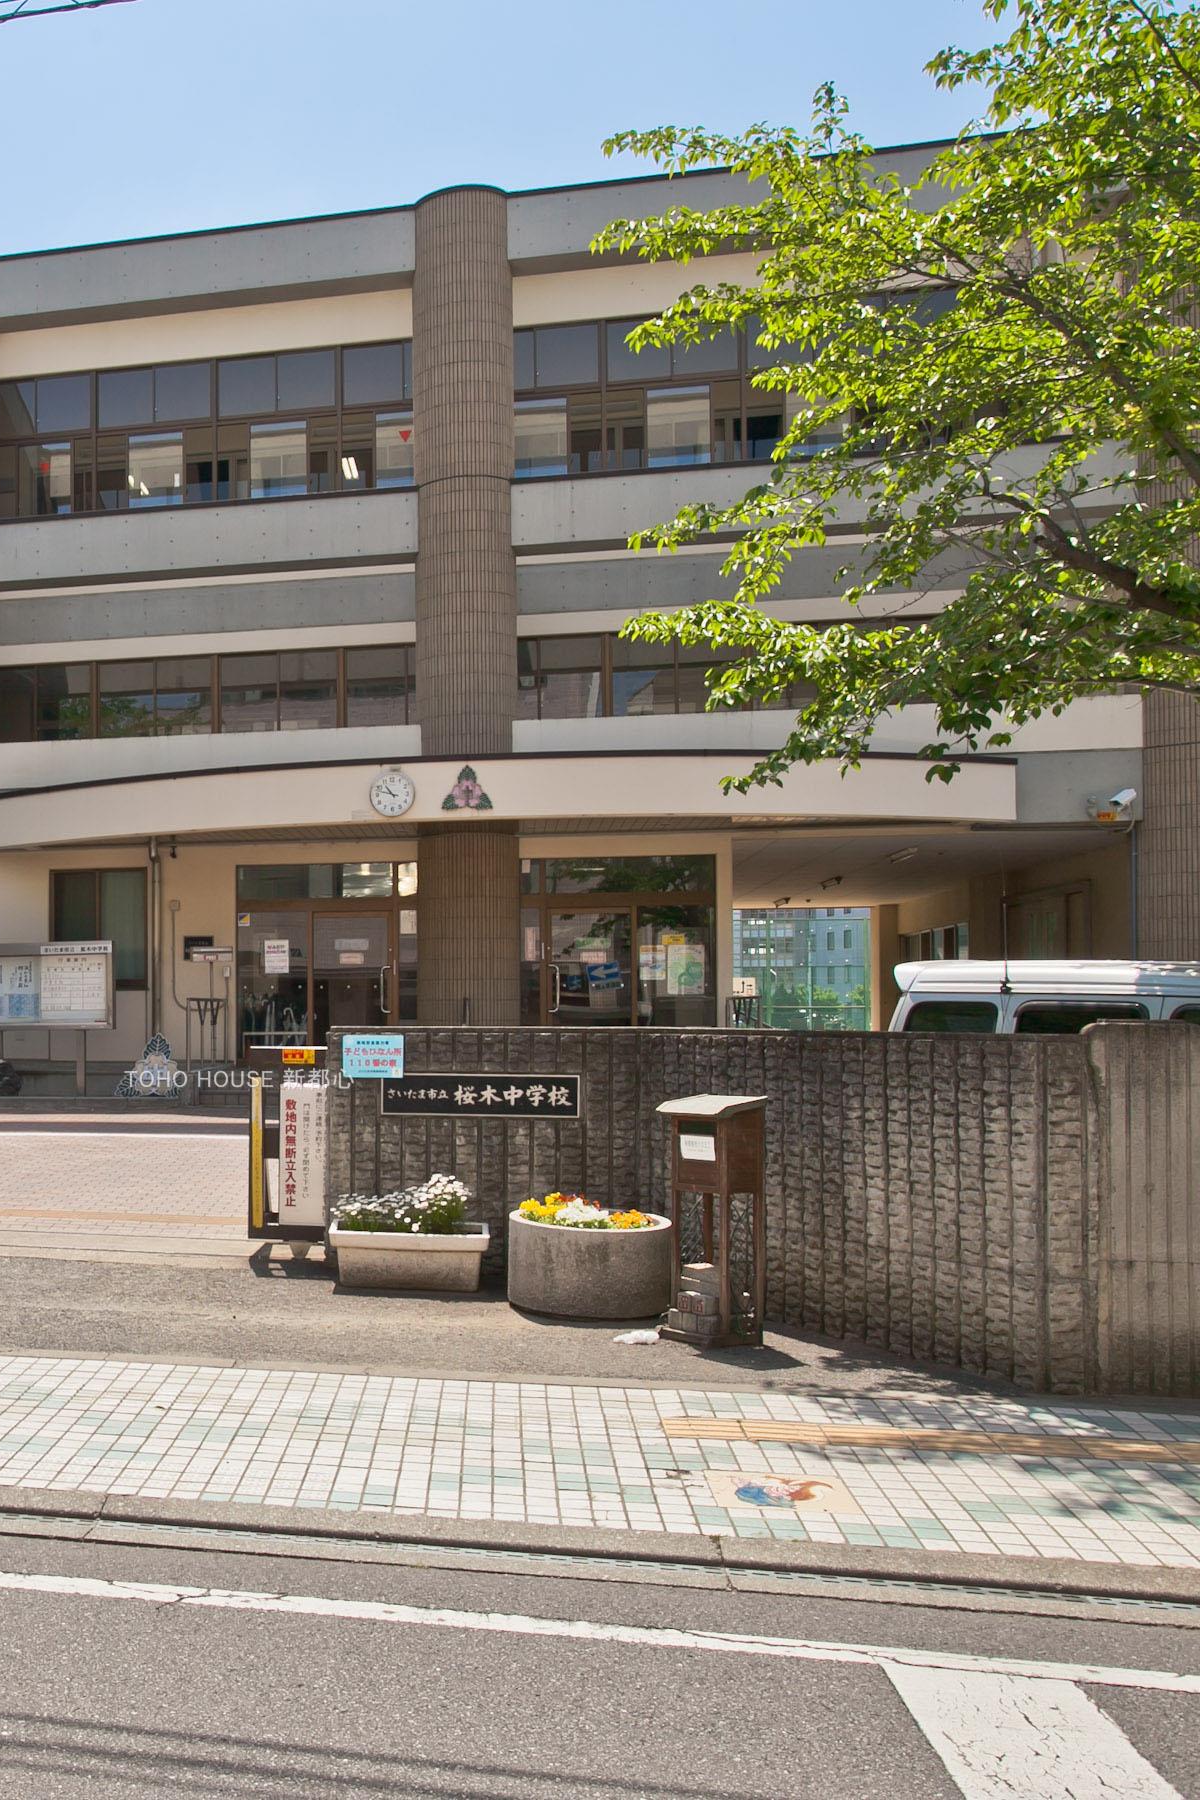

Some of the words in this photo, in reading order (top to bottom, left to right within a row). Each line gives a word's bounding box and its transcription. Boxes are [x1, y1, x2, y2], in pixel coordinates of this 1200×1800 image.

[386, 1087, 449, 1100] さいたま市立
[453, 1083, 573, 1107] 桜木中学校
[285, 1098, 297, 1207] 敷地内無断立入禁止
